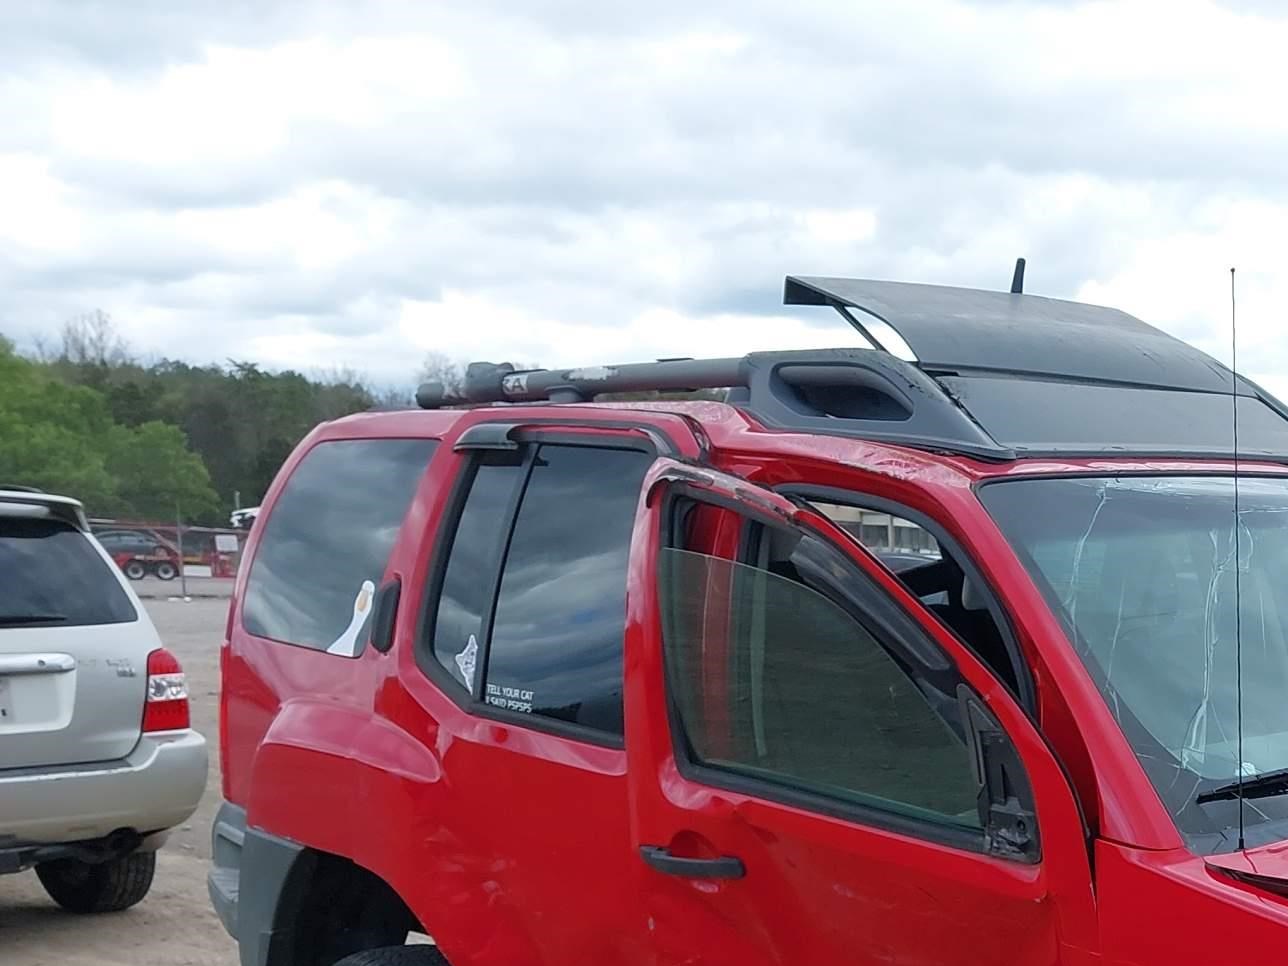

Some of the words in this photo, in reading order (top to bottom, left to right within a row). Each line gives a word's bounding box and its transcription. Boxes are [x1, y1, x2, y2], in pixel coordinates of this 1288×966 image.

[486, 684, 501, 695] TELL
[502, 687, 519, 698] YOUR
[521, 690, 534, 700] CAT
[490, 697, 507, 707] SAID
